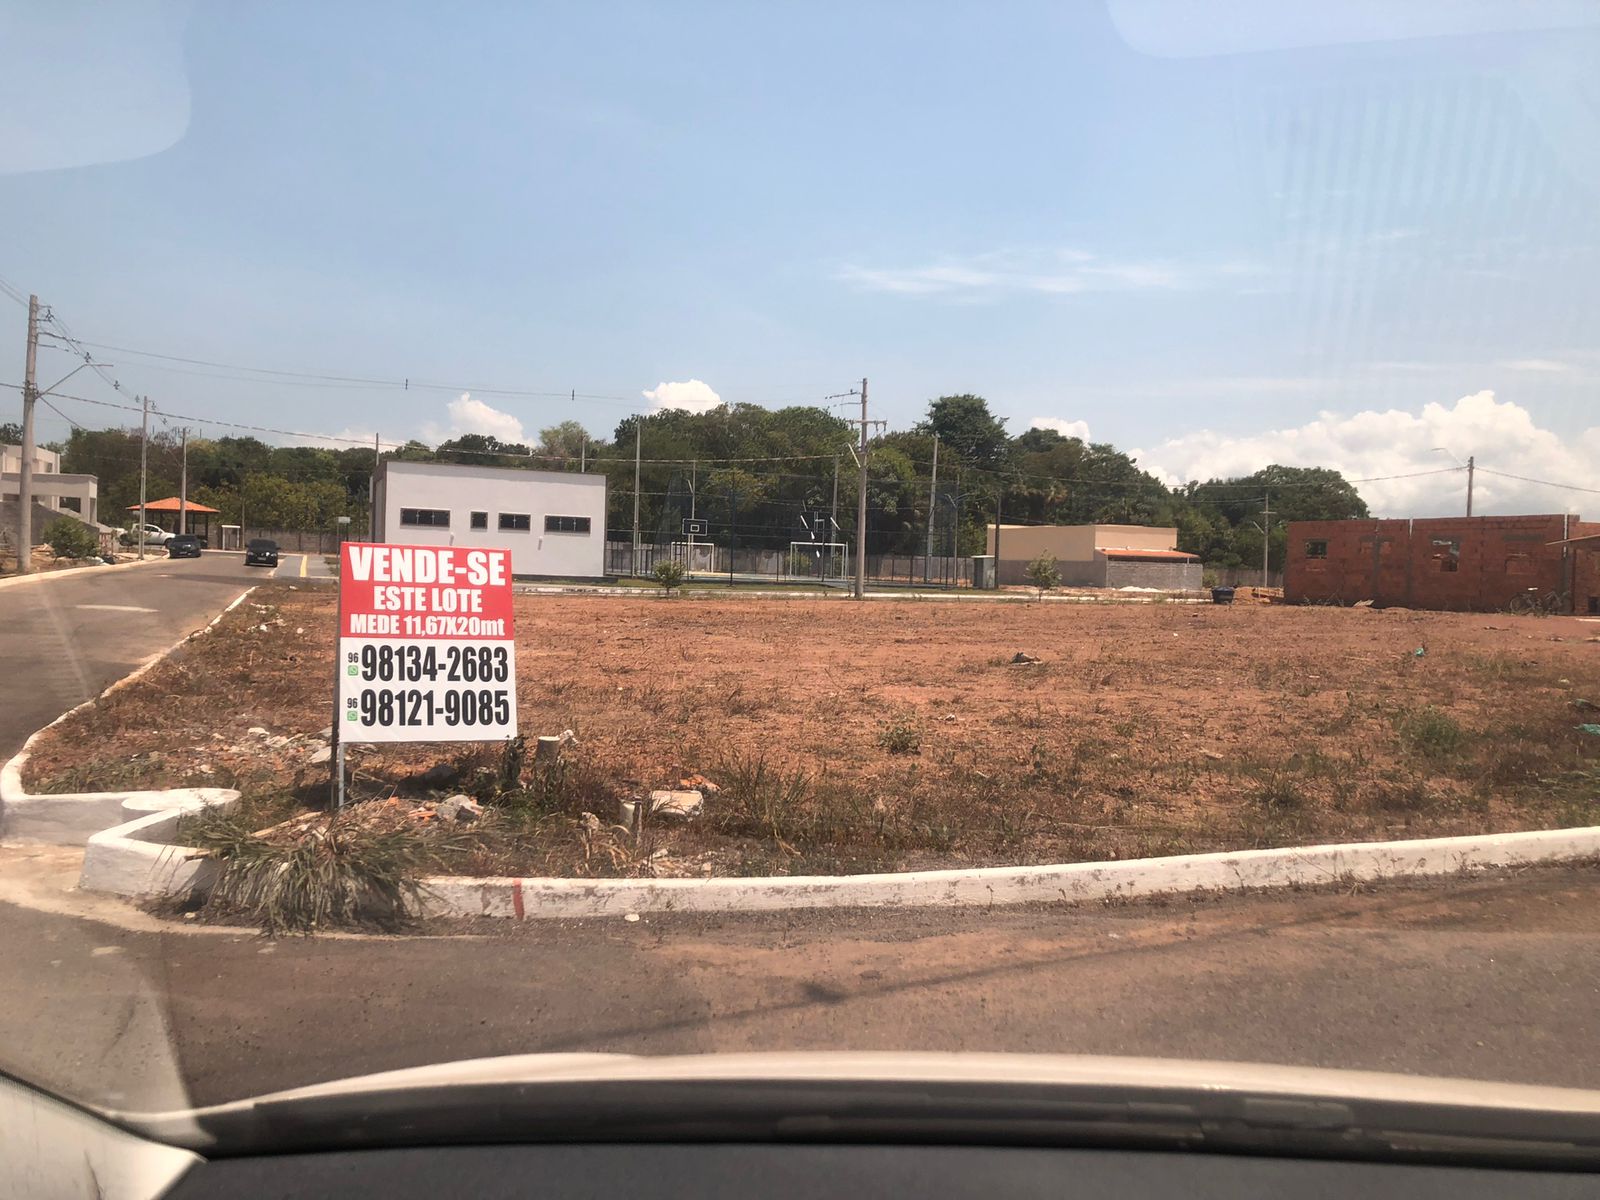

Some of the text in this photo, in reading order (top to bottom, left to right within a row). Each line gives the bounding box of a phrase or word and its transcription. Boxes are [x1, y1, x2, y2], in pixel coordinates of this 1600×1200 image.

[349, 546, 506, 586] VENDE-SE
[373, 586, 483, 613] ESTE LOTE
[350, 614, 506, 637] MEDE 11,67X20mt
[347, 644, 509, 683] 96 98134-2683
[347, 688, 510, 727] 96 98121-9085
